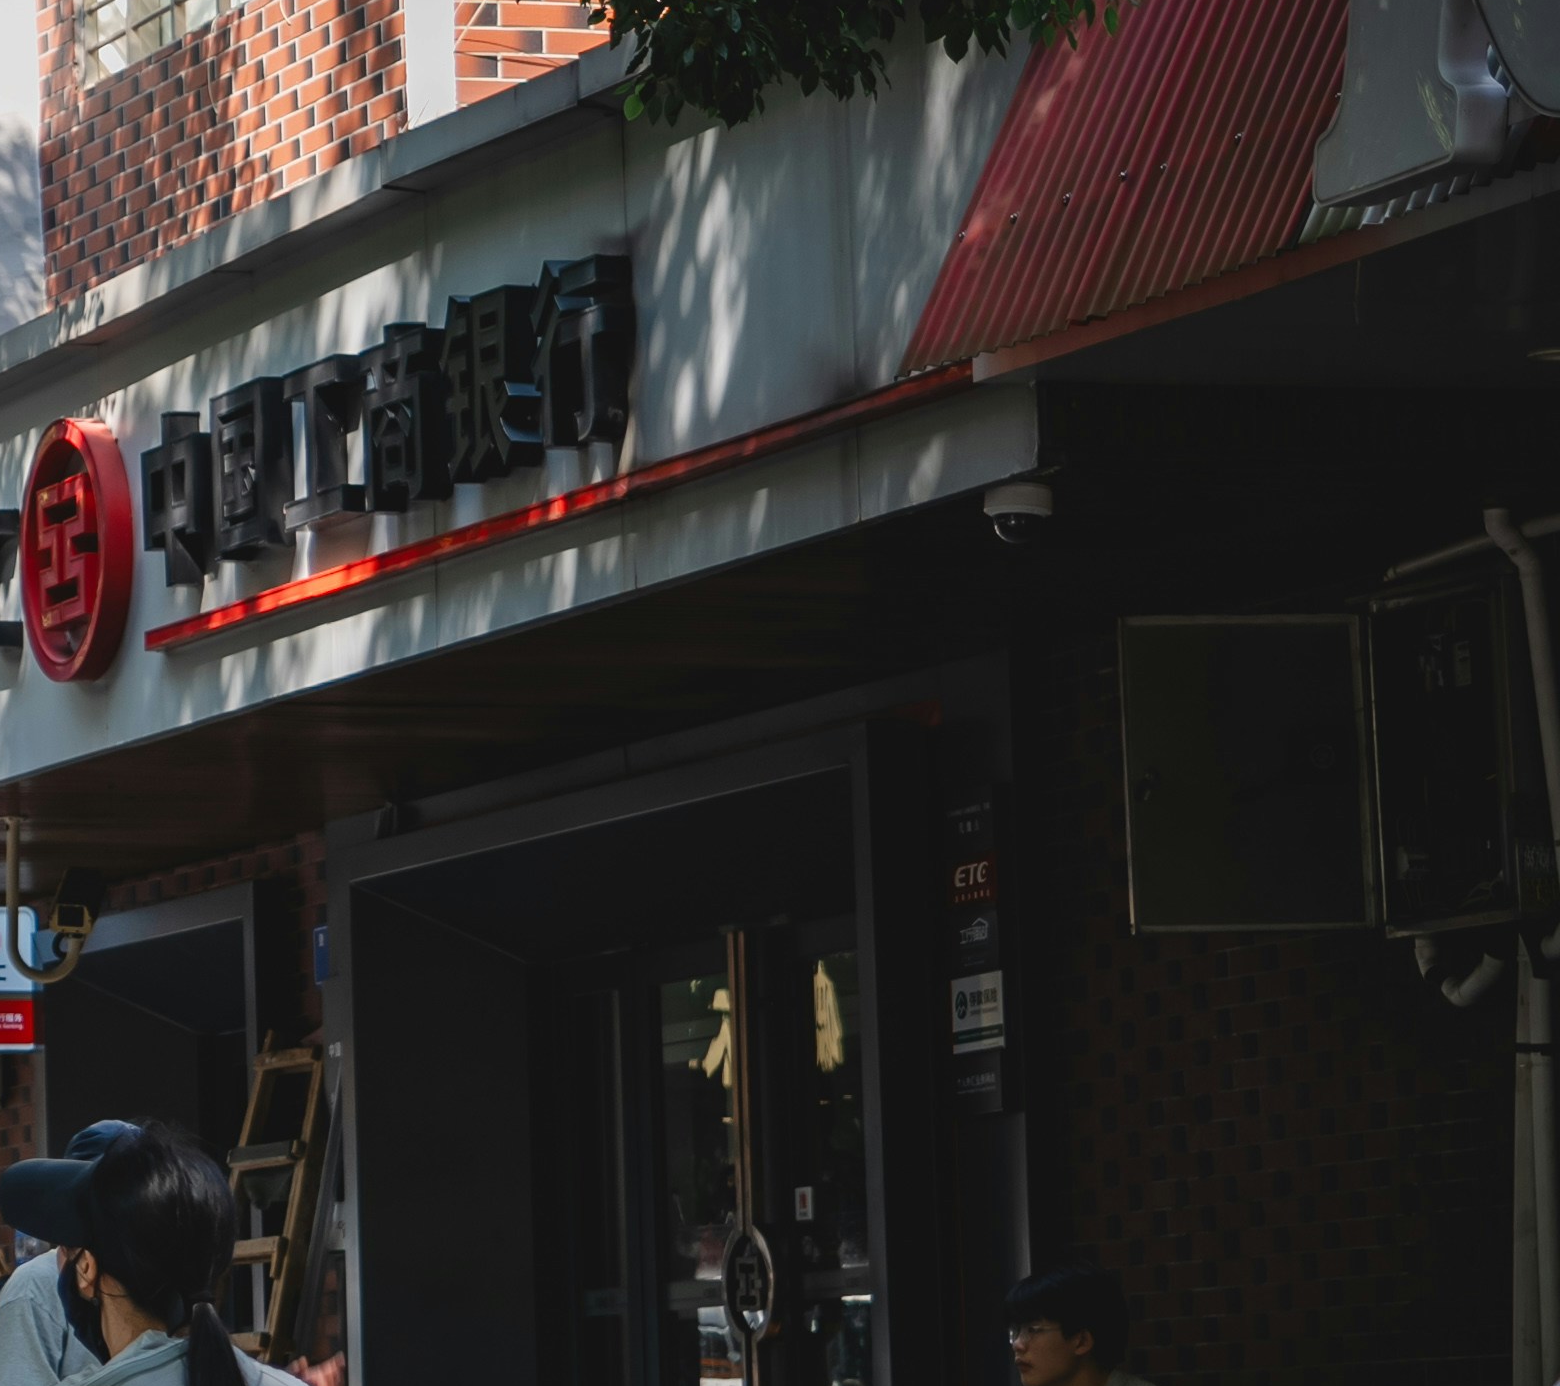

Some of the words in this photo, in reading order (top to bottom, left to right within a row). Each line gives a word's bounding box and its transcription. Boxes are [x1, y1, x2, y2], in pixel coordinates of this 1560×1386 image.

[141, 254, 633, 587] 中国工商银行
